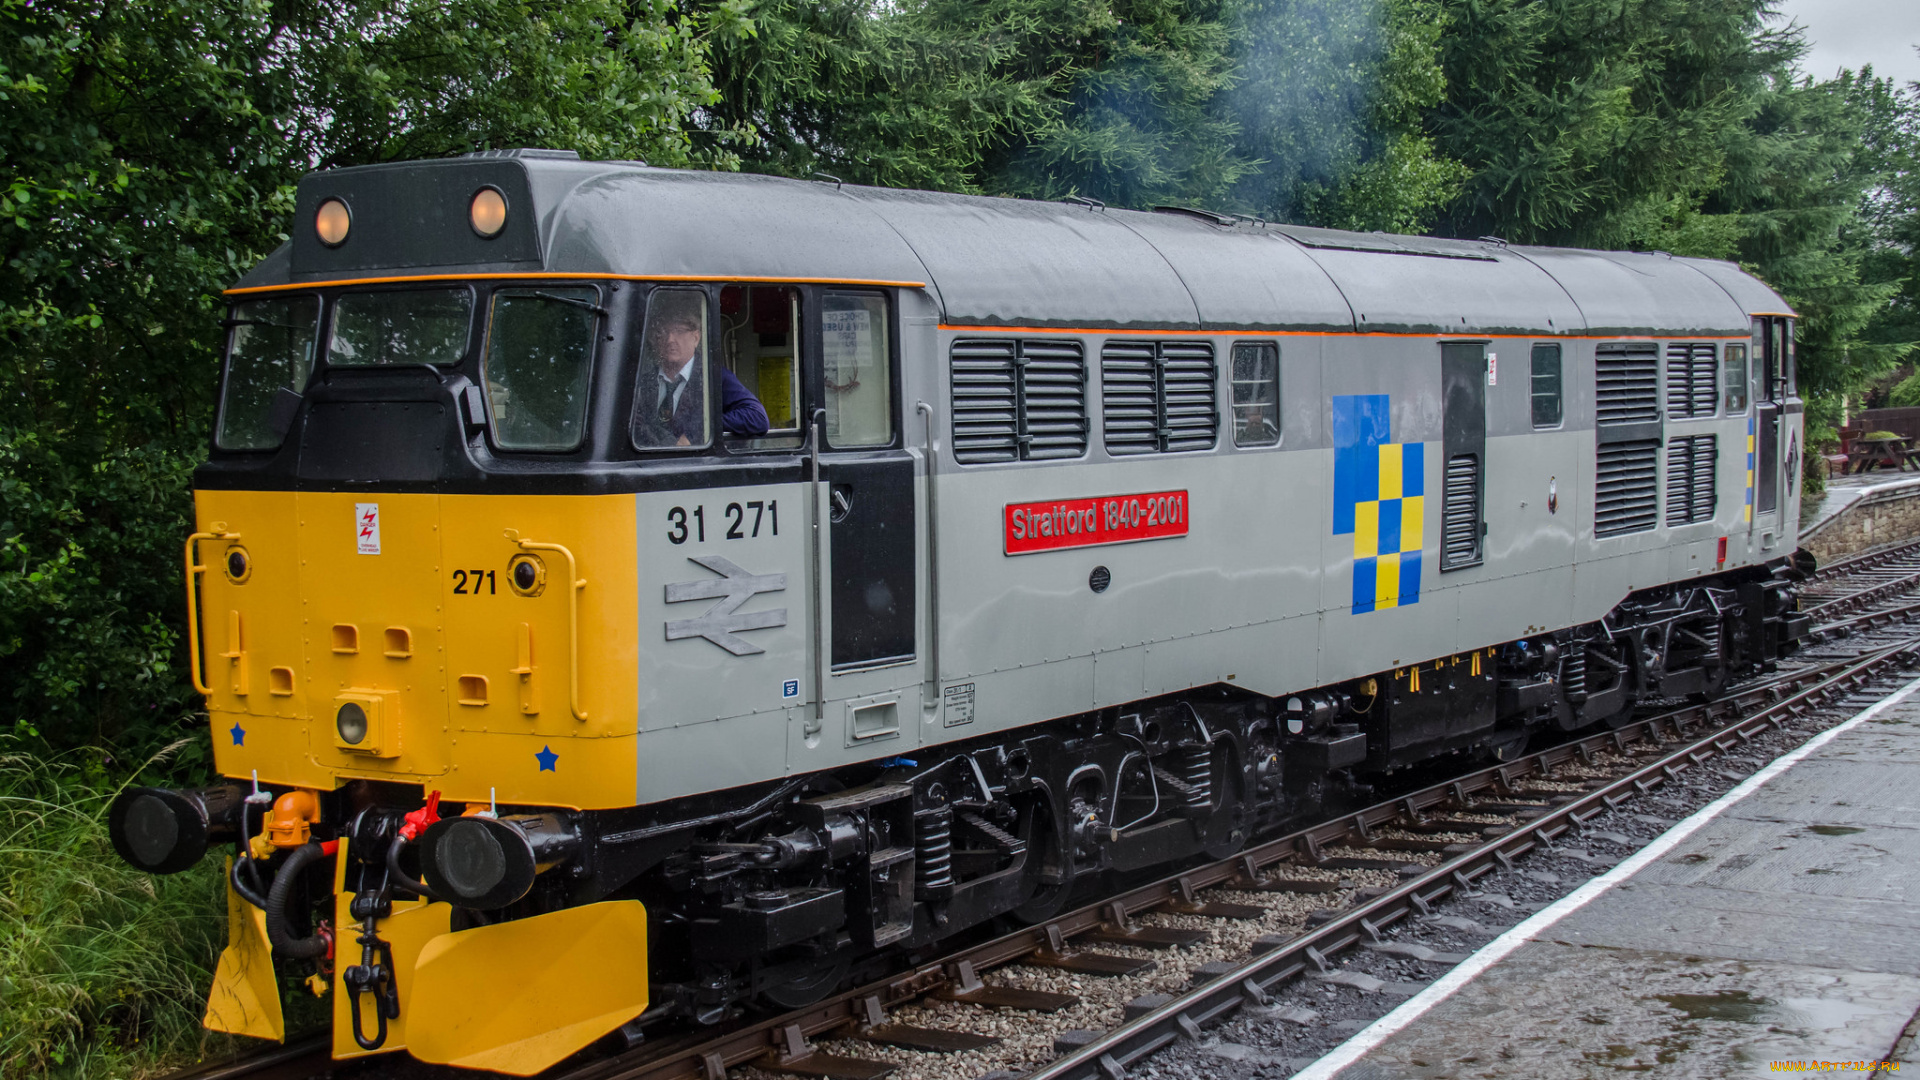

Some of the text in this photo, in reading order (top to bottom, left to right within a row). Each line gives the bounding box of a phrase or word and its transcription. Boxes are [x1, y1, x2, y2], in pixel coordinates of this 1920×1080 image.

[667, 500, 778, 545] 31 271
[1012, 495, 1183, 540] Stratford 1840-2001
[452, 569, 496, 595] 271
